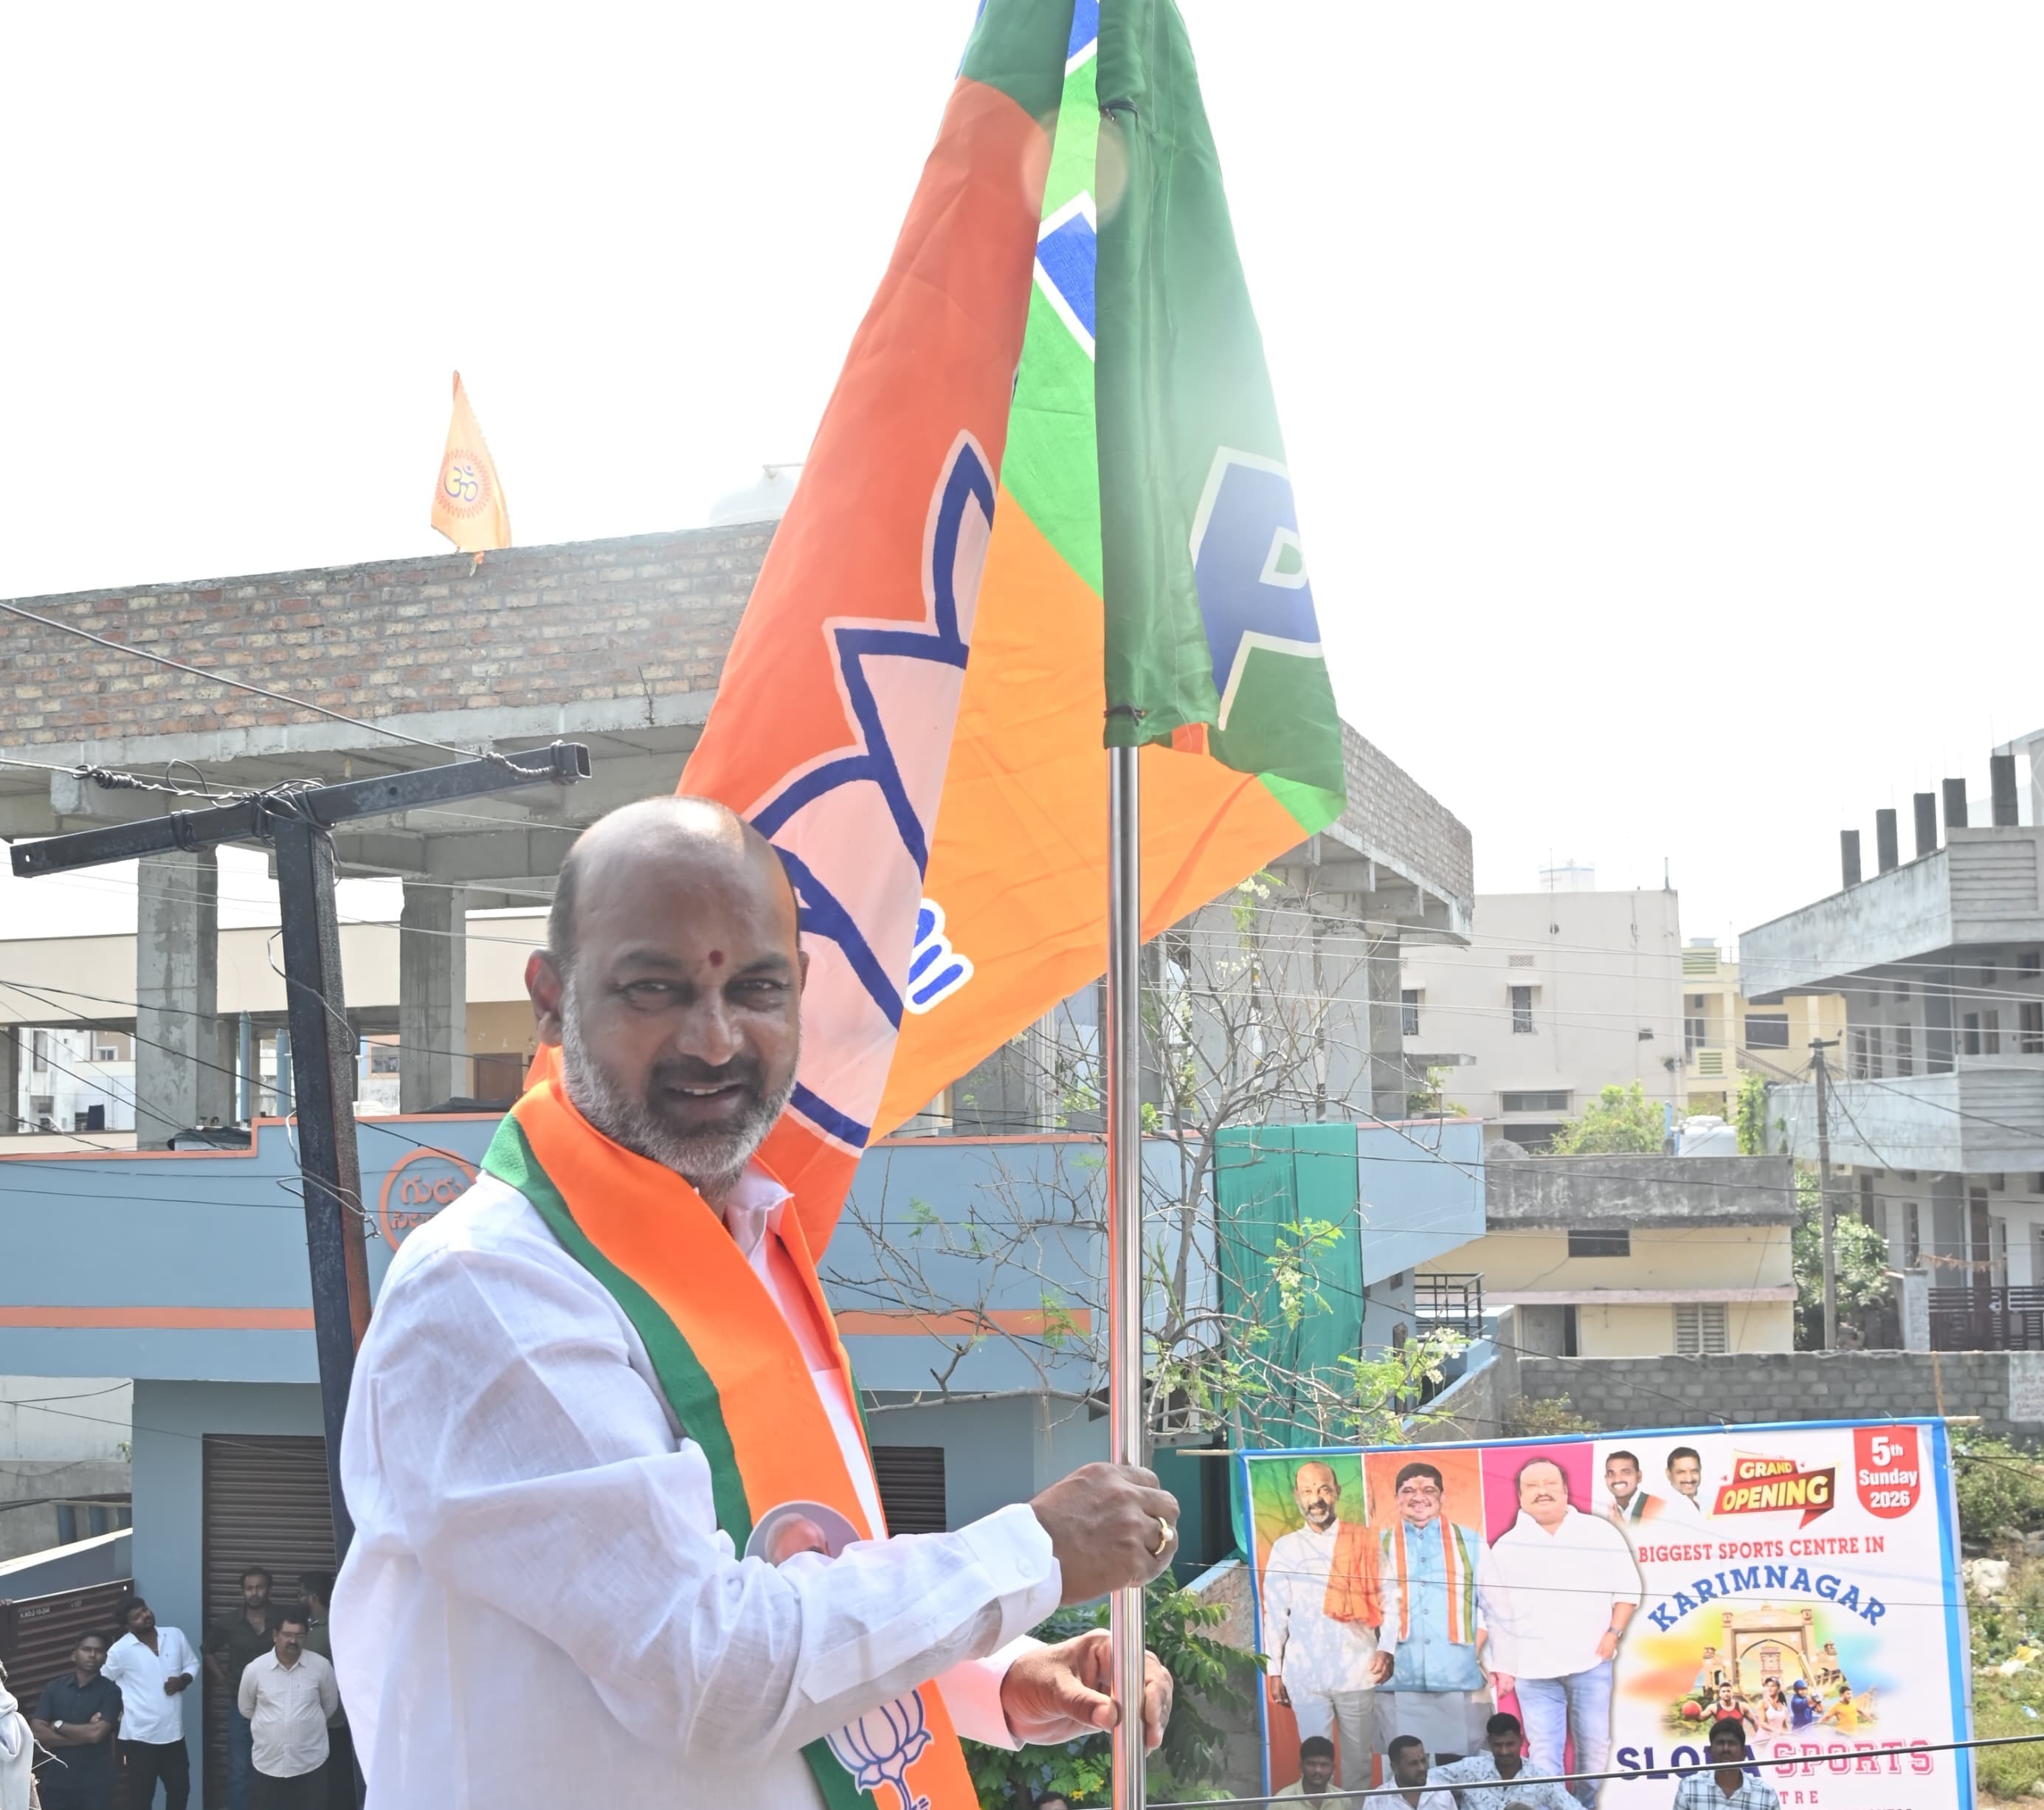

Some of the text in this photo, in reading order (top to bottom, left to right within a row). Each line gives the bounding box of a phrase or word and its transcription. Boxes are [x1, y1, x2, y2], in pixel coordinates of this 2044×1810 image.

[1871, 1436, 1904, 1466] 5th
[1739, 1461, 1793, 1479] GRAND
[1859, 1468, 1918, 1487] Sunday
[1722, 1475, 1829, 1512] OPENING
[1870, 1490, 1911, 1508] 2026
[1638, 1536, 1885, 1563] BIGGEST SPORTS CENTRE IN
[1647, 1564, 1887, 1632] KARIMNAGAR
[1773, 1738, 1935, 1778] SPORTS
